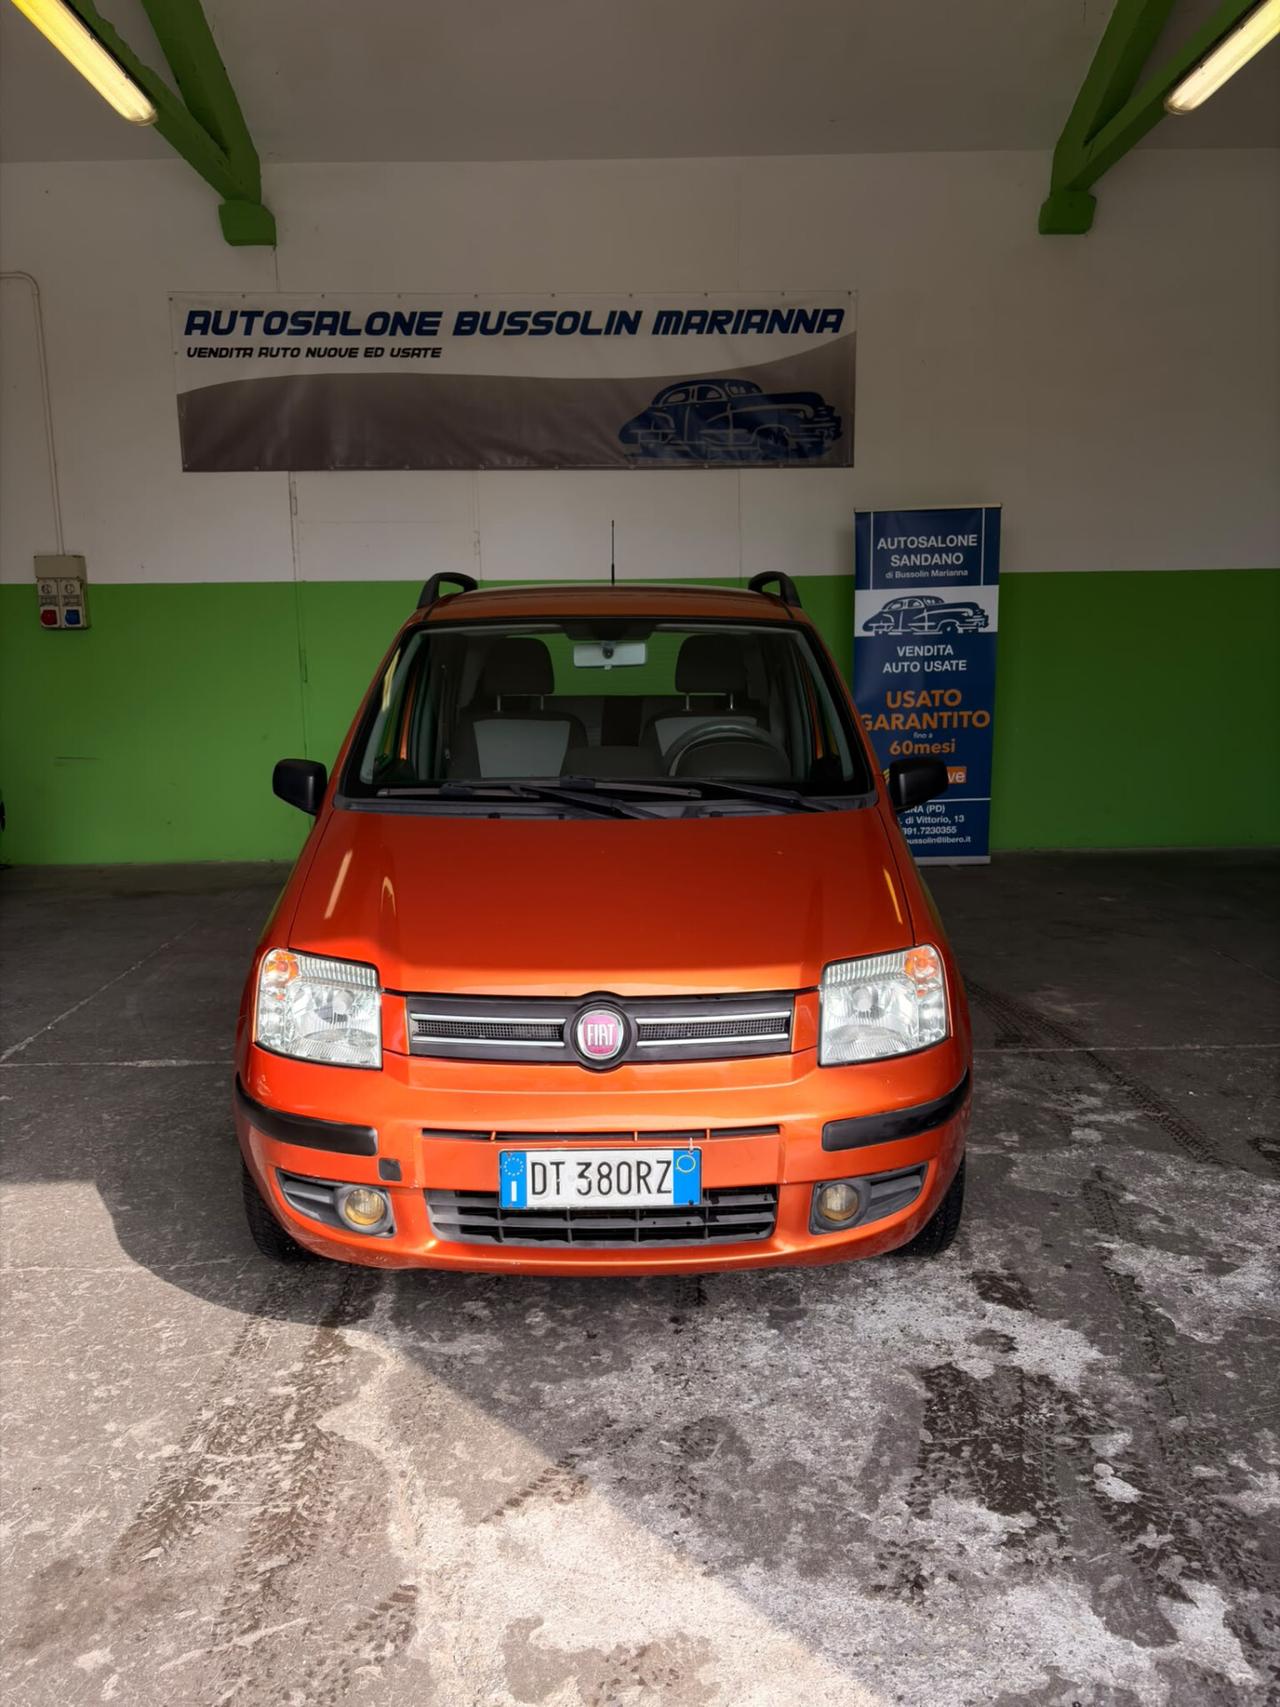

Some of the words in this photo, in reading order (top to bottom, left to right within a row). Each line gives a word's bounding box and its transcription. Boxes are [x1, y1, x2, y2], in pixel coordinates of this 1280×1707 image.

[184, 310, 443, 336] AUTOSALONE
[452, 310, 643, 336] BUSSOLIN
[651, 308, 845, 335] MARIANNA
[186, 347, 253, 359] VENDITA
[258, 347, 300, 359] AUTO
[305, 347, 359, 359] NUOVE
[363, 347, 384, 359] ED
[390, 347, 442, 359] USATE
[877, 534, 978, 550] AUTOSALONE
[890, 552, 964, 567] SANDANO
[885, 571, 893, 580] di
[895, 570, 929, 580] Bussolin
[931, 568, 968, 578] Marianna
[896, 645, 954, 657] VENDITA
[882, 662, 921, 674] AUTO
[924, 660, 967, 672] USATE
[886, 689, 962, 709] USATO
[860, 710, 991, 732] GARANTITO
[889, 738, 956, 755] 60mesi
[926, 804, 946, 814] (PD)
[905, 816, 914, 825] di
[916, 815, 952, 826] Vittorio,
[954, 814, 965, 823] 13
[587, 1023, 616, 1047] FIAT
[530, 1160, 566, 1196] DT
[575, 1159, 673, 1196] 380RZ
